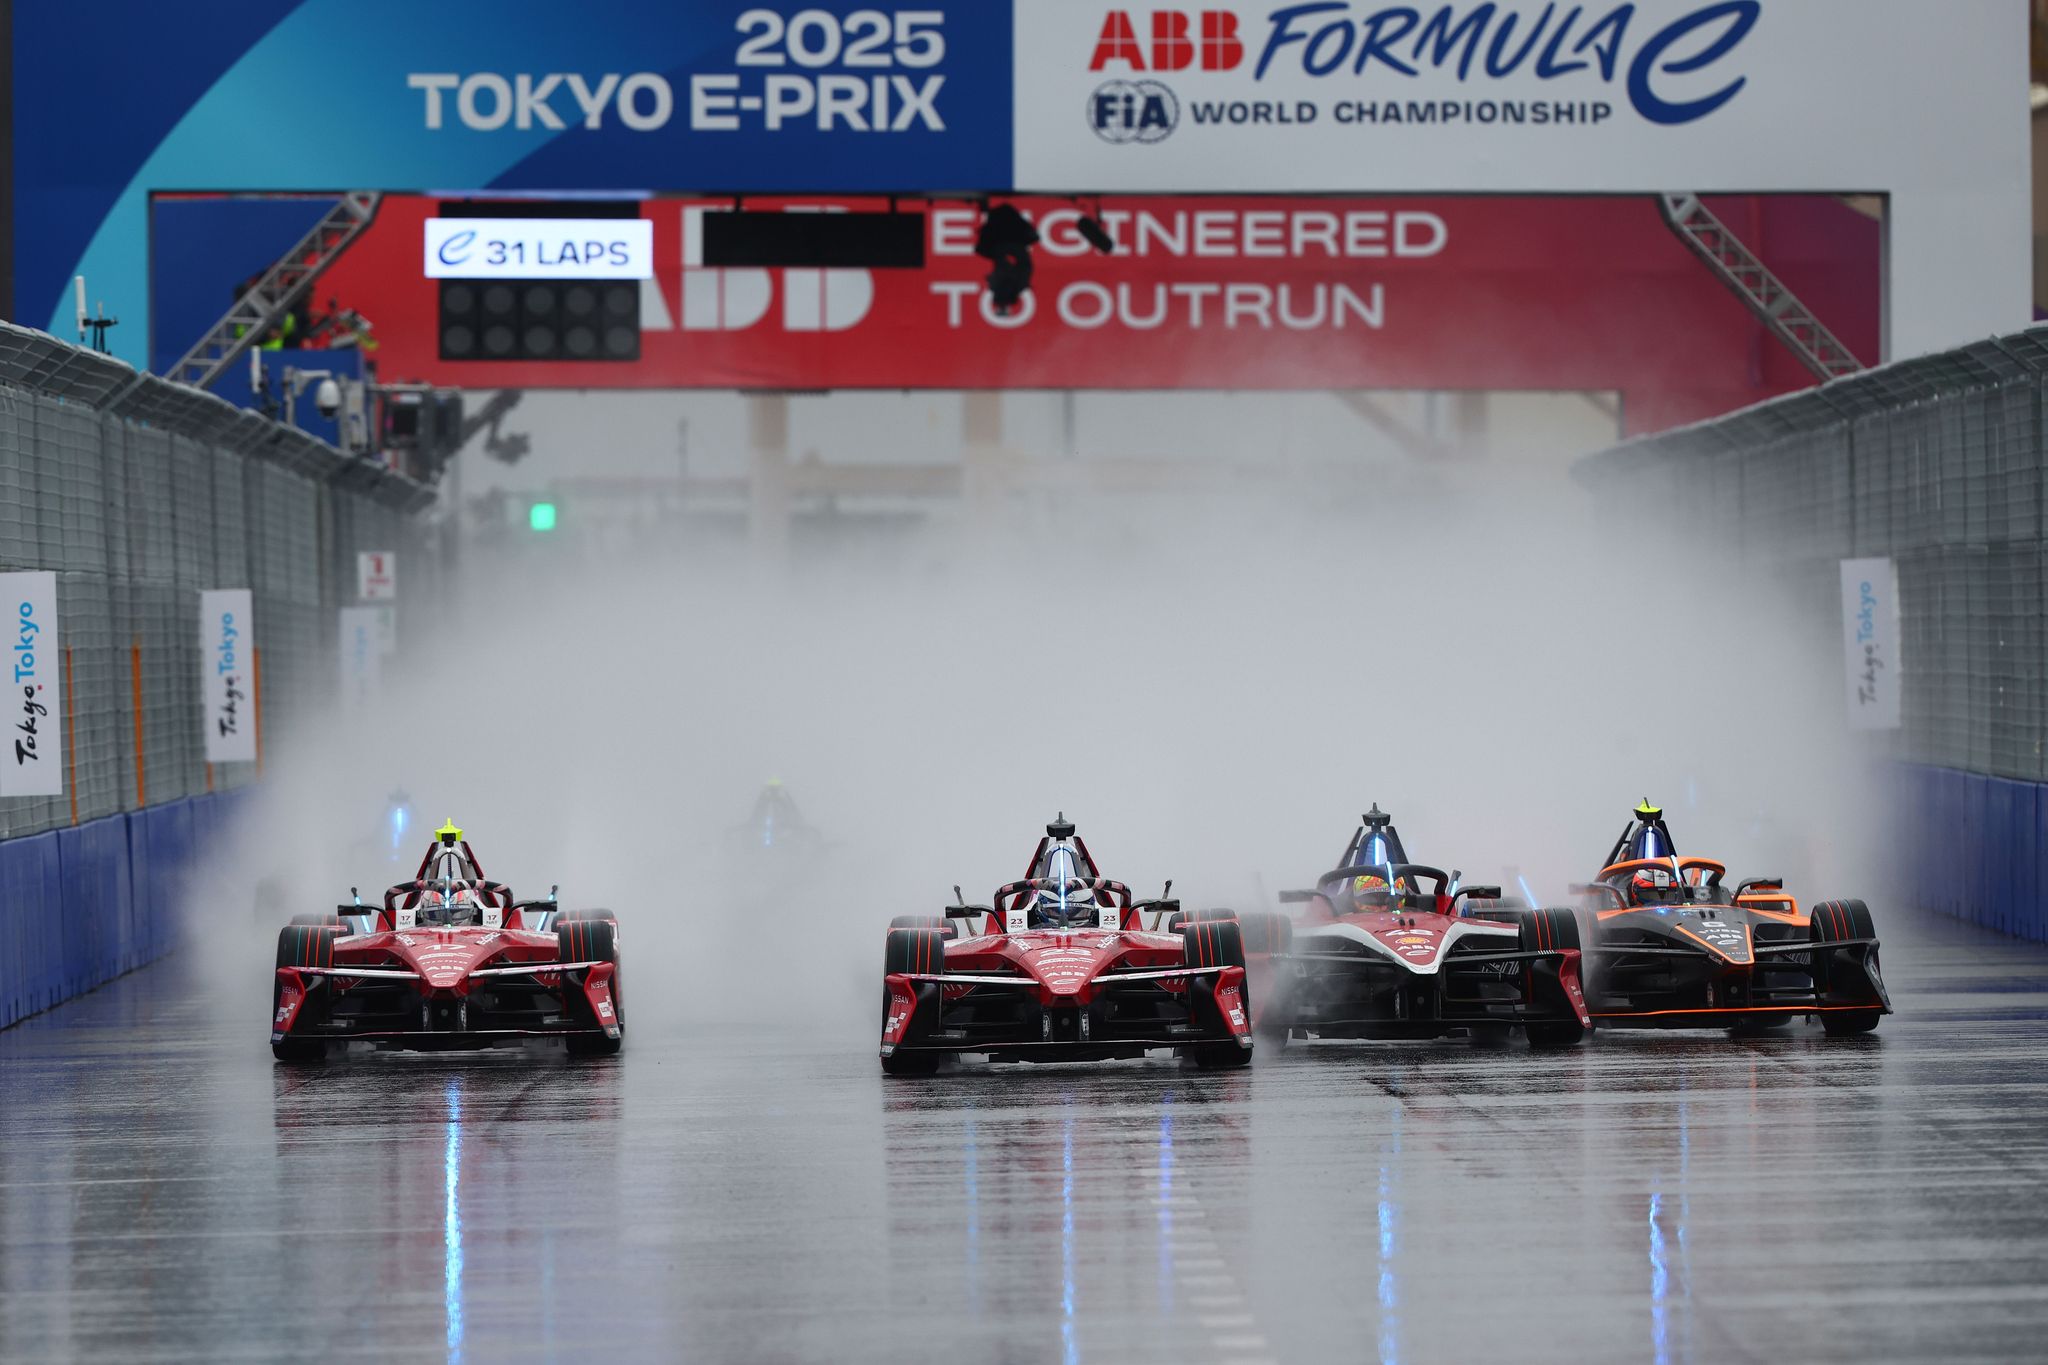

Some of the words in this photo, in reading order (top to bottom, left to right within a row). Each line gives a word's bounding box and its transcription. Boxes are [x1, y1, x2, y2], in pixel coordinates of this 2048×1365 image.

[736, 9, 945, 67] 2025
[1089, 11, 1243, 71] ABB
[1254, 1, 1636, 83] FORMULA
[407, 73, 673, 131] TOKYO
[690, 75, 946, 131] E-PRIX
[1191, 101, 1318, 125] WORLD
[1333, 100, 1613, 125] CHAMPIONSHIP
[486, 240, 526, 266] 31
[537, 240, 630, 267] LAPS
[931, 210, 1448, 257] EGINEERED
[930, 282, 1036, 328] TO
[1057, 282, 1384, 329] OUTRUN
[1856, 581, 1878, 643] Tokyo
[14, 602, 40, 684] Tokyo
[218, 612, 239, 675] Tokyo
[15, 684, 48, 766] Tokyo
